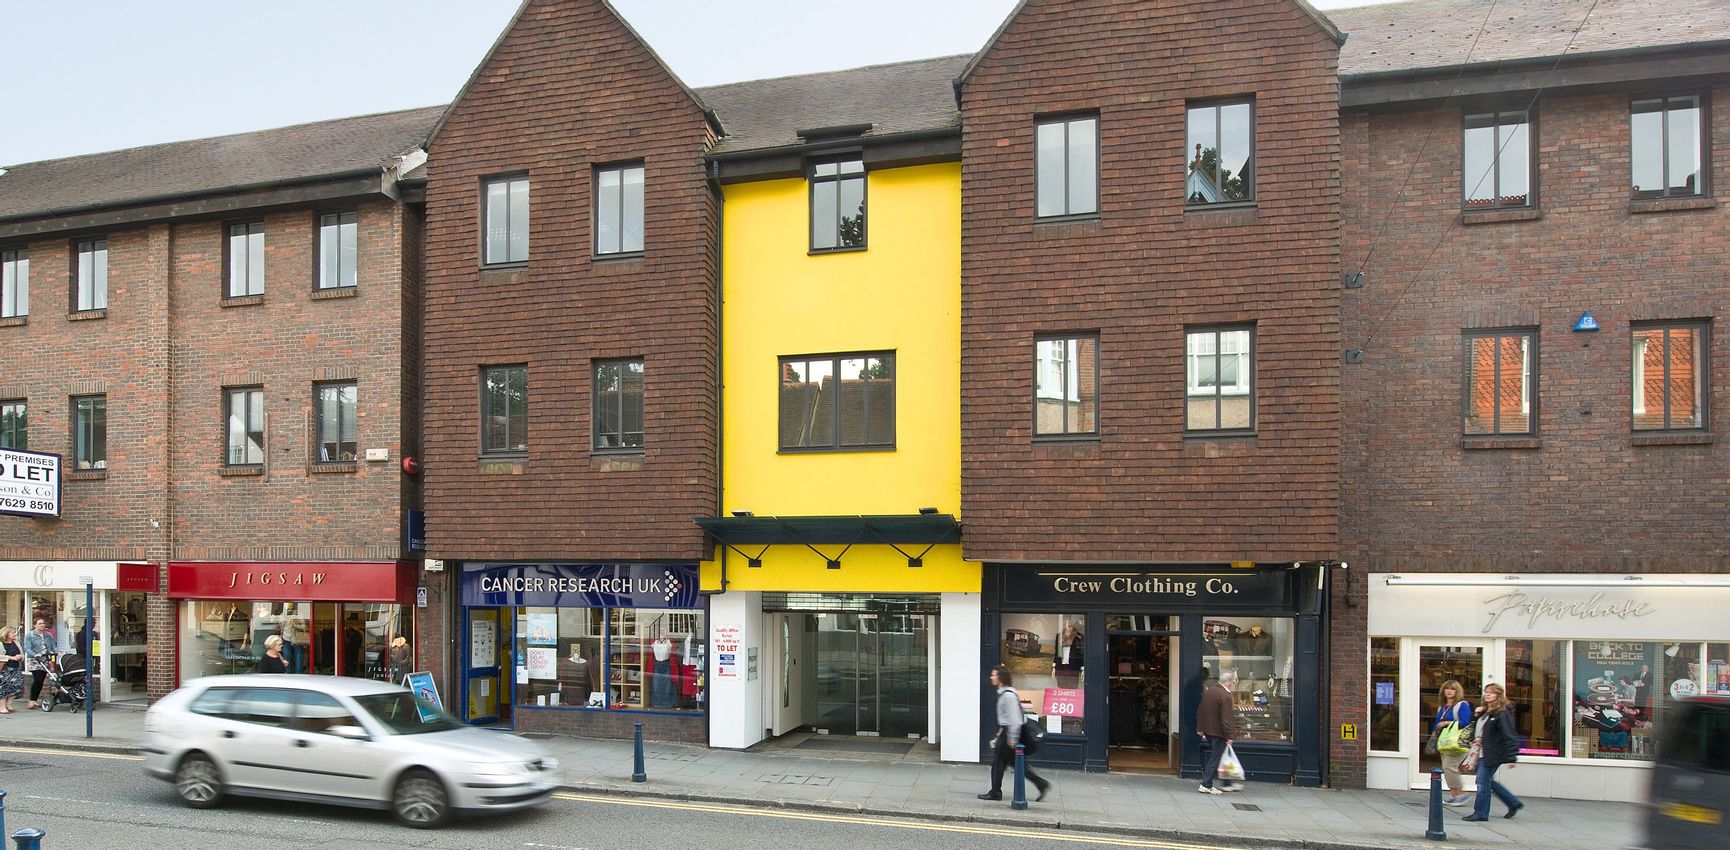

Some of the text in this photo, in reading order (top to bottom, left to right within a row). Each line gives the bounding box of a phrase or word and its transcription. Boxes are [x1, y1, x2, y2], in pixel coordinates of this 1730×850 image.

[5, 454, 54, 466] PREMISES
[13, 464, 54, 482] LET
[21, 486, 31, 495] &
[35, 487, 51, 496] Co
[30, 500, 54, 510] 8510
[229, 572, 326, 587] JIGSAW
[481, 577, 661, 593] CANCER RESEARCH UK
[1054, 577, 1239, 597] Crew Clothing Co.
[1482, 590, 1656, 634] Paperchase
[1627, 643, 1643, 651] TO
[1689, 683, 1695, 691] 2
[1051, 702, 1075, 714] £80
[1343, 724, 1355, 738] H
